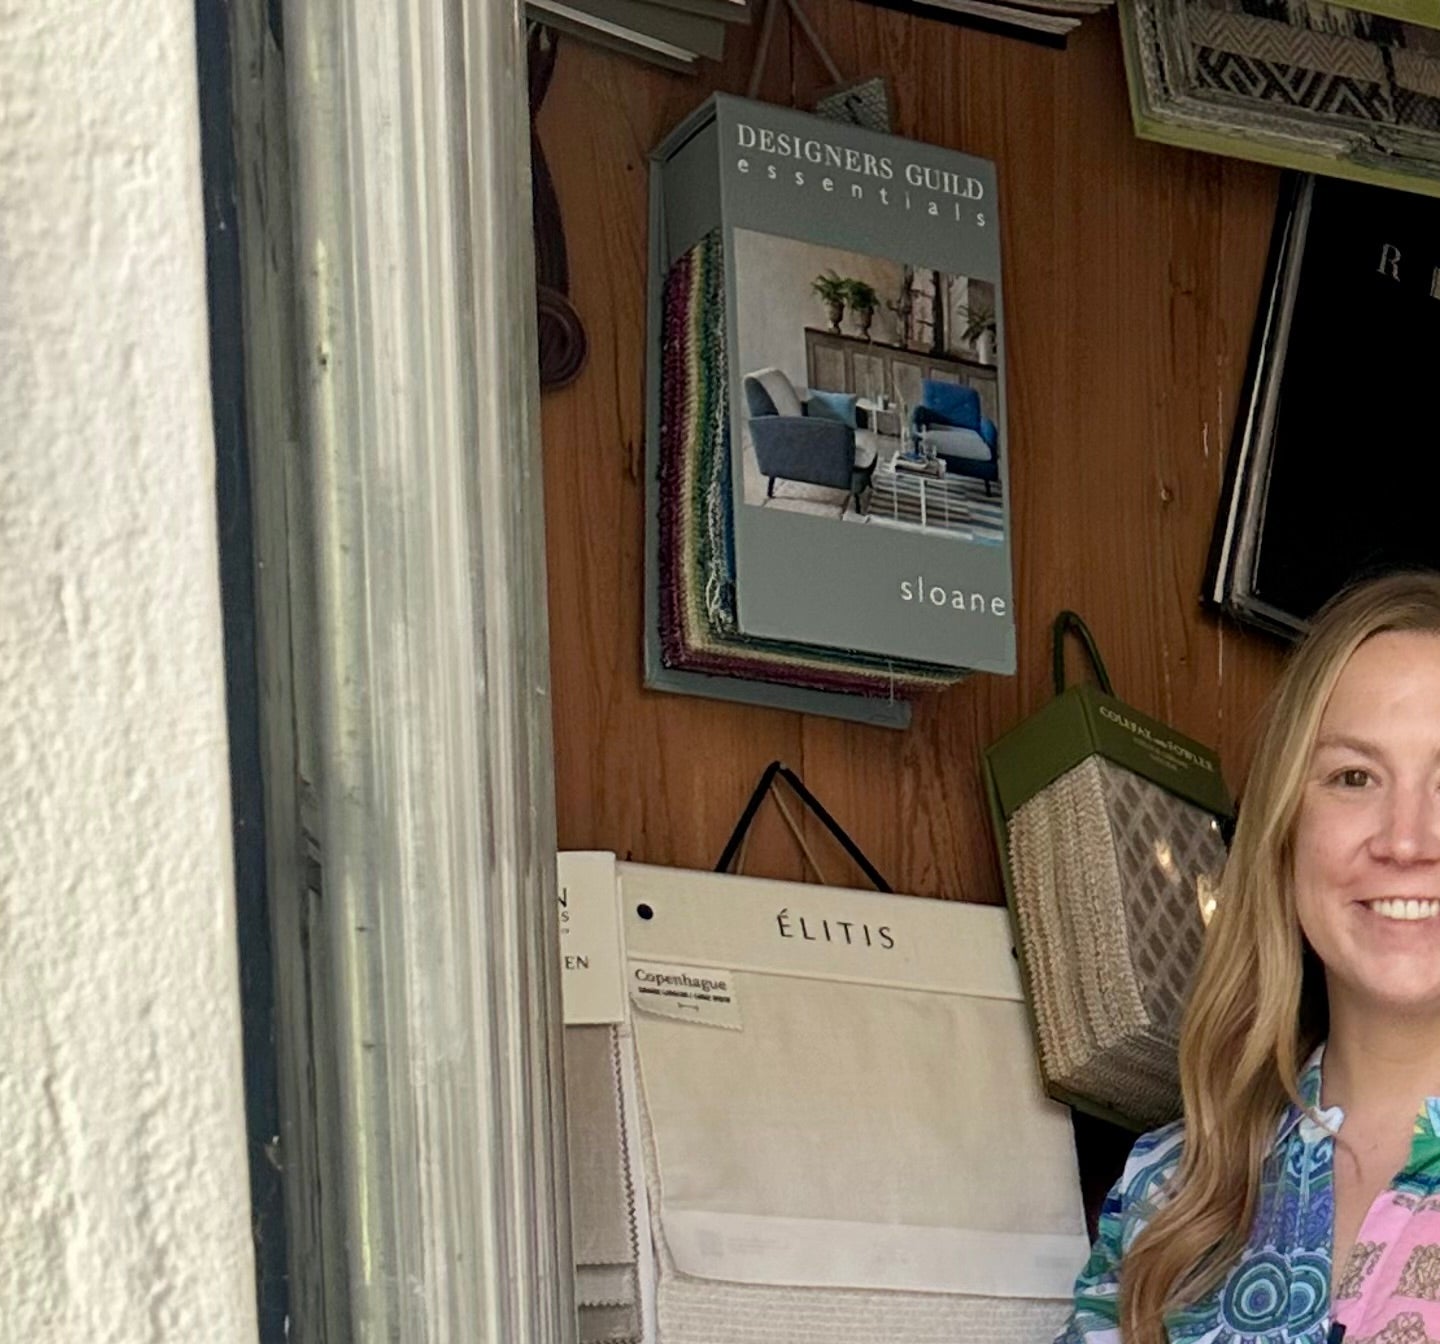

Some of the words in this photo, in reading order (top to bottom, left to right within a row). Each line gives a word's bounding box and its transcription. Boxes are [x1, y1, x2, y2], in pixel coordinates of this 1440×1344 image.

[737, 124, 893, 179] DESIGNERS
[905, 164, 984, 200] GUILD
[737, 158, 986, 227] essentials
[900, 576, 1006, 616] sloane
[776, 908, 895, 950] ÉLITIS
[564, 955, 589, 970] EN
[635, 968, 727, 993] Copenhague
